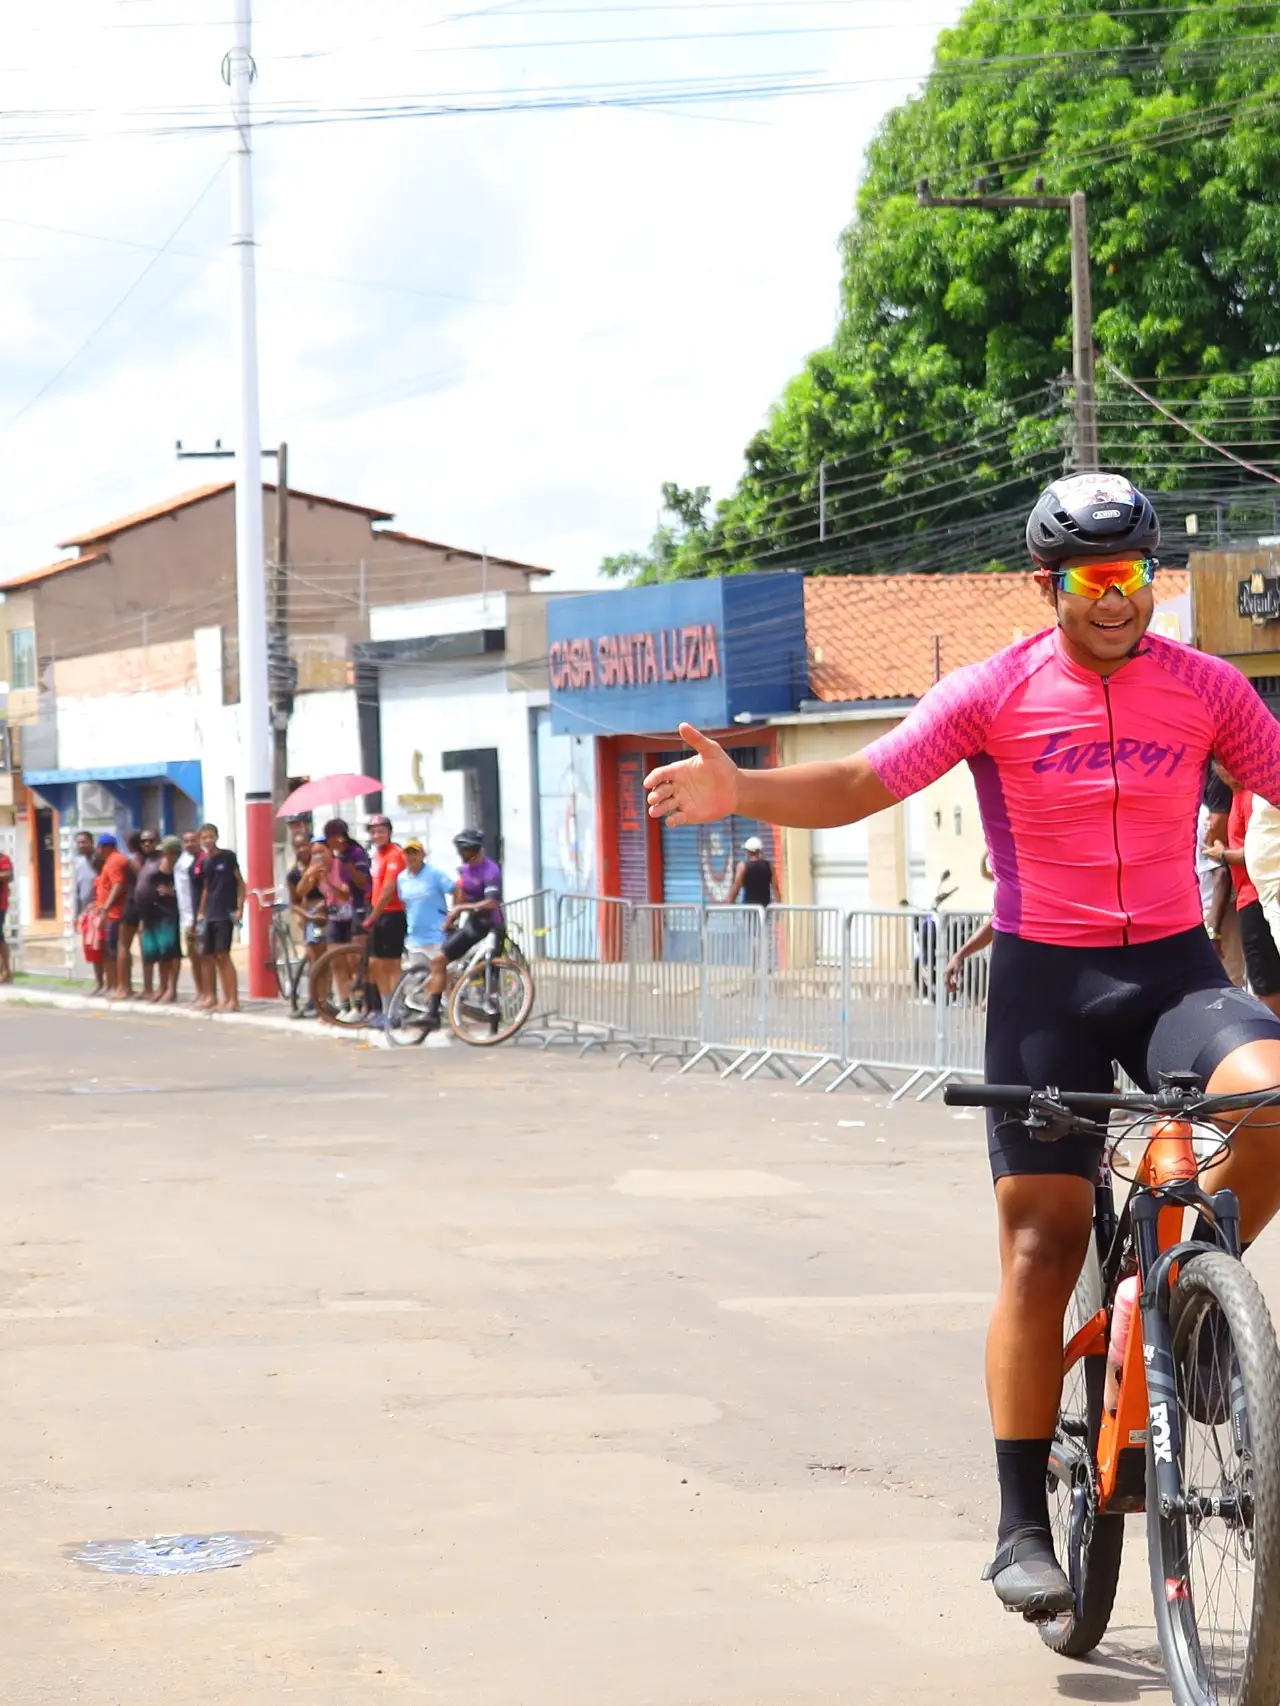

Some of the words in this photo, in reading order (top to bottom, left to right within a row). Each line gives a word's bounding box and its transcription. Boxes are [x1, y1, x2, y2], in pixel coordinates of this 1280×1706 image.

[550, 639, 598, 691] CASA
[598, 632, 660, 688] SANTA
[660, 624, 722, 682] LUZIA
[1149, 1402, 1173, 1466] FOX
